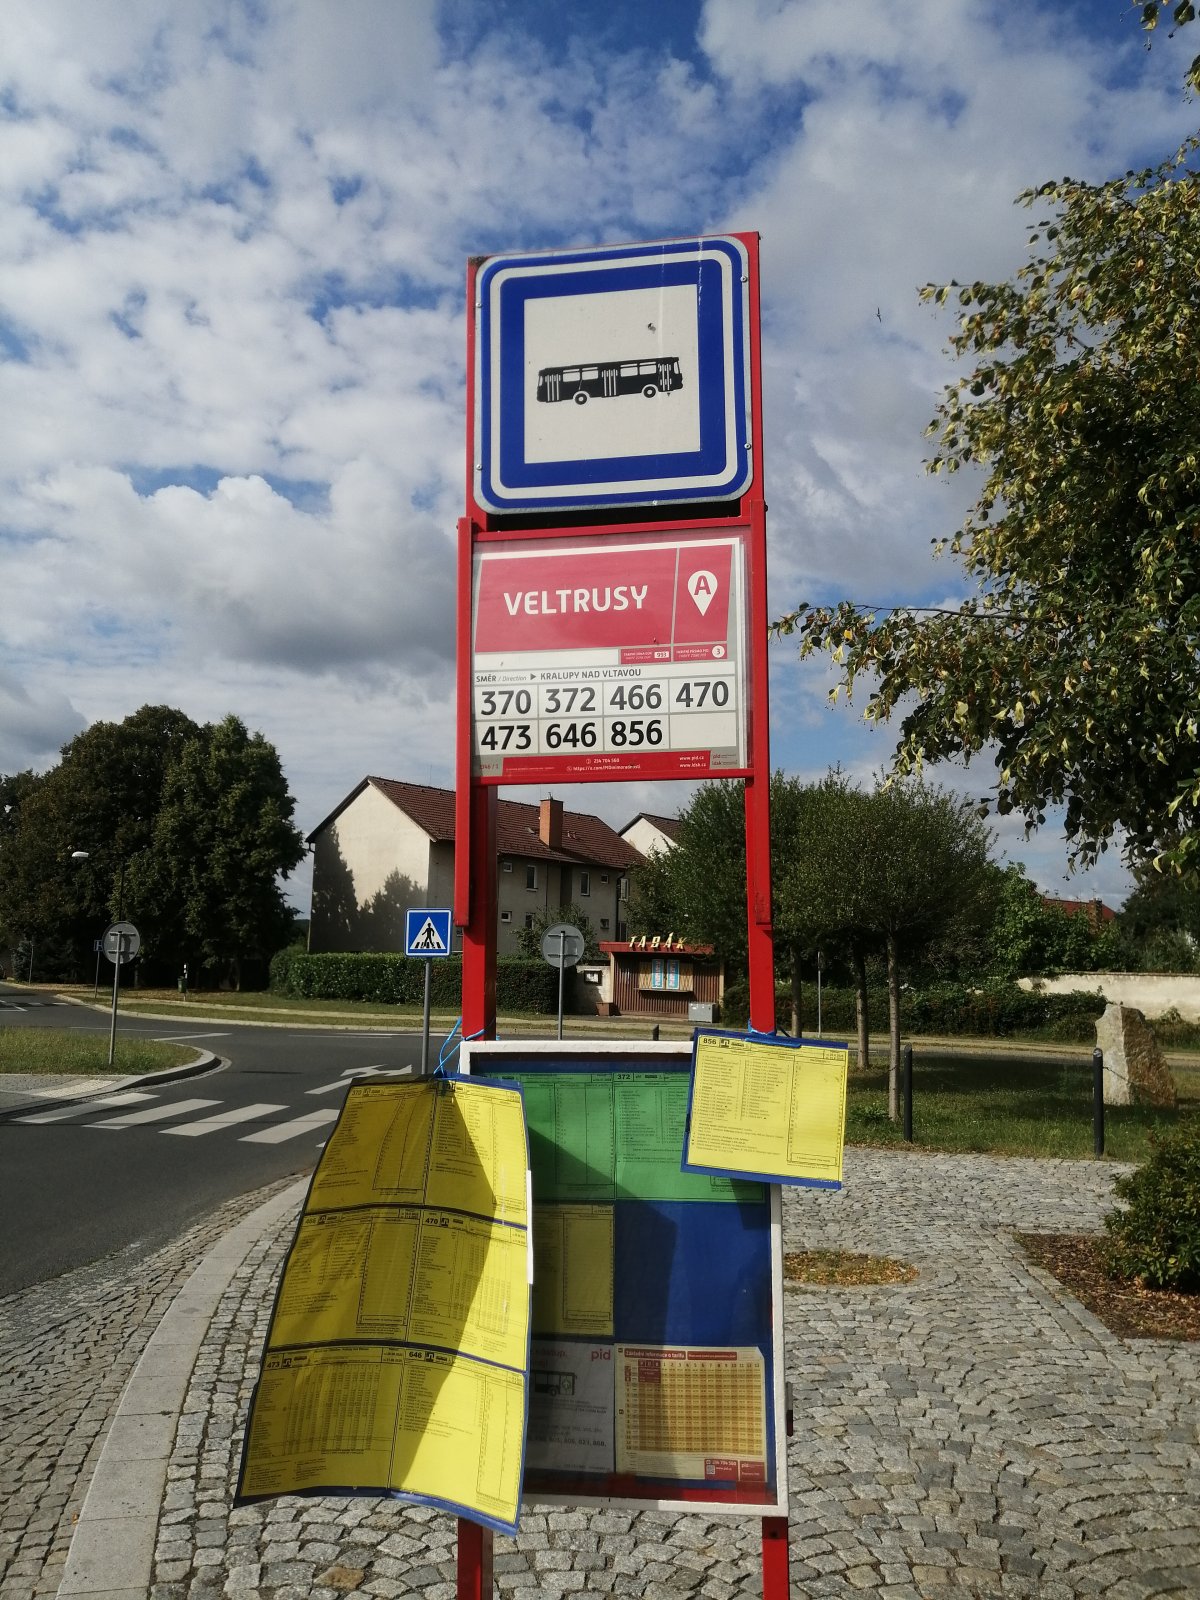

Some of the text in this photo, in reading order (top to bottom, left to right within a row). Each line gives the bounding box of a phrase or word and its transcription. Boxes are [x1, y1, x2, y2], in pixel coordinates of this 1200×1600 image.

[694, 575, 711, 596] A
[504, 585, 648, 616] VELTRUSY
[476, 674, 497, 683] SMĚR
[540, 668, 642, 680] KRALUPY NAD VLTAVOU
[481, 690, 532, 716] 370
[545, 687, 596, 713] 372
[609, 683, 662, 711] 466
[676, 681, 729, 708] 470
[481, 725, 532, 750] 473
[546, 722, 597, 748] 646
[610, 719, 663, 746] 856
[628, 932, 687, 950] TABÁK
[266, 1361, 280, 1369] 473
[591, 1348, 611, 1361] pid
